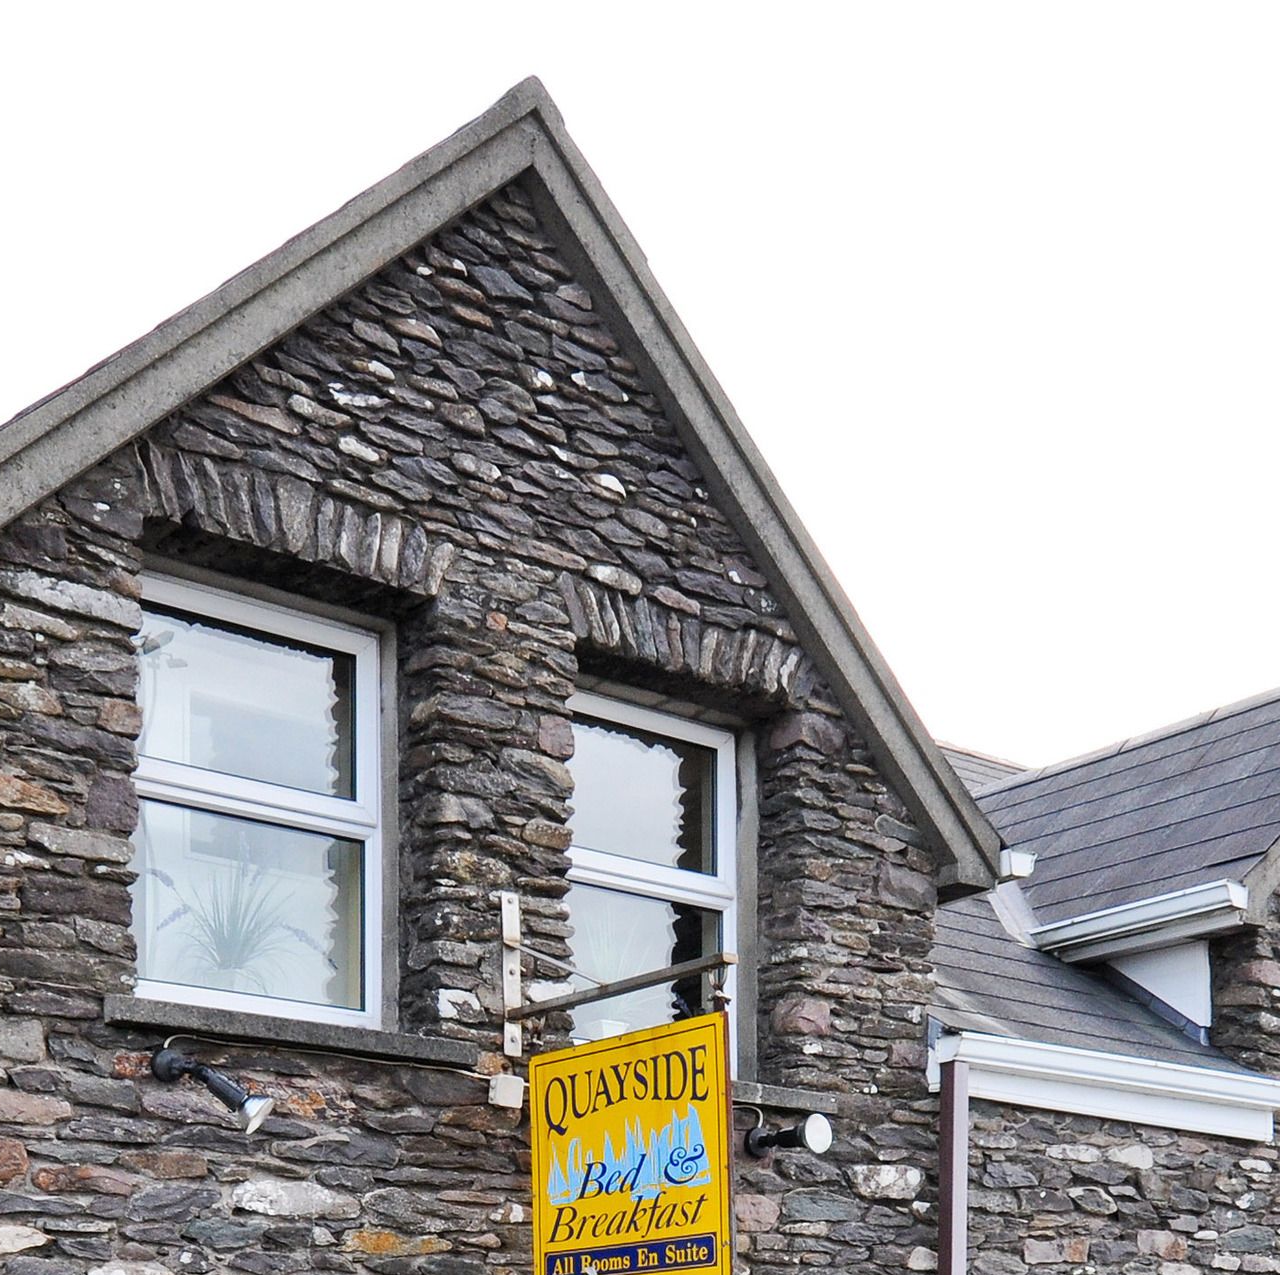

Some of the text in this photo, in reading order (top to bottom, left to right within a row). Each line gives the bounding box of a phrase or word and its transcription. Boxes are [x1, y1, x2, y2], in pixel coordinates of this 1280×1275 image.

[544, 1044, 709, 1139] QUAYSIDE
[577, 1144, 706, 1200] Bed &
[547, 1191, 708, 1244] Breakfast
[581, 1255, 631, 1274] Rooms
[637, 1248, 658, 1267] En
[665, 1242, 709, 1265] Suite
